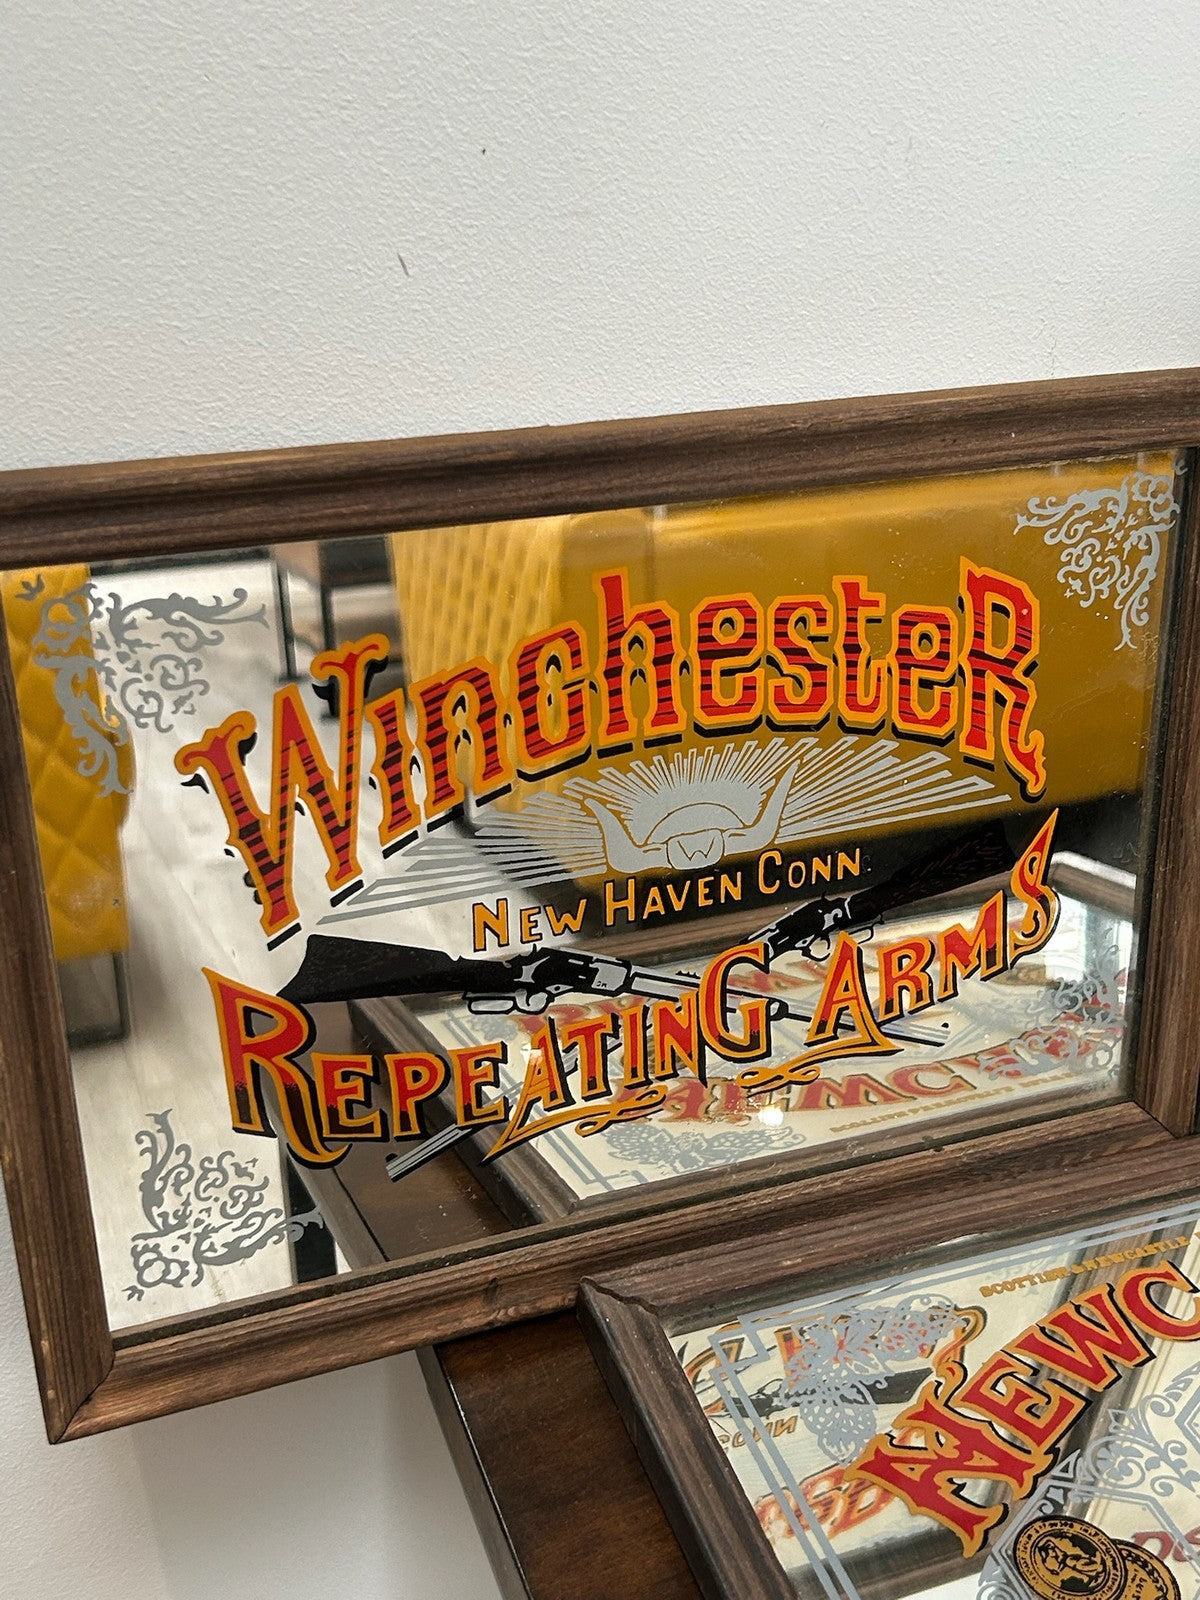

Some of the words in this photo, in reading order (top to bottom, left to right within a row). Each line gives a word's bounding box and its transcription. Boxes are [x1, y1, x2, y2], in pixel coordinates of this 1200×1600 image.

[201, 942, 771, 1168] REPEATING
[804, 808, 1061, 1062] ARMS
[472, 897, 588, 952] NEW
[604, 870, 742, 926] HAVEN
